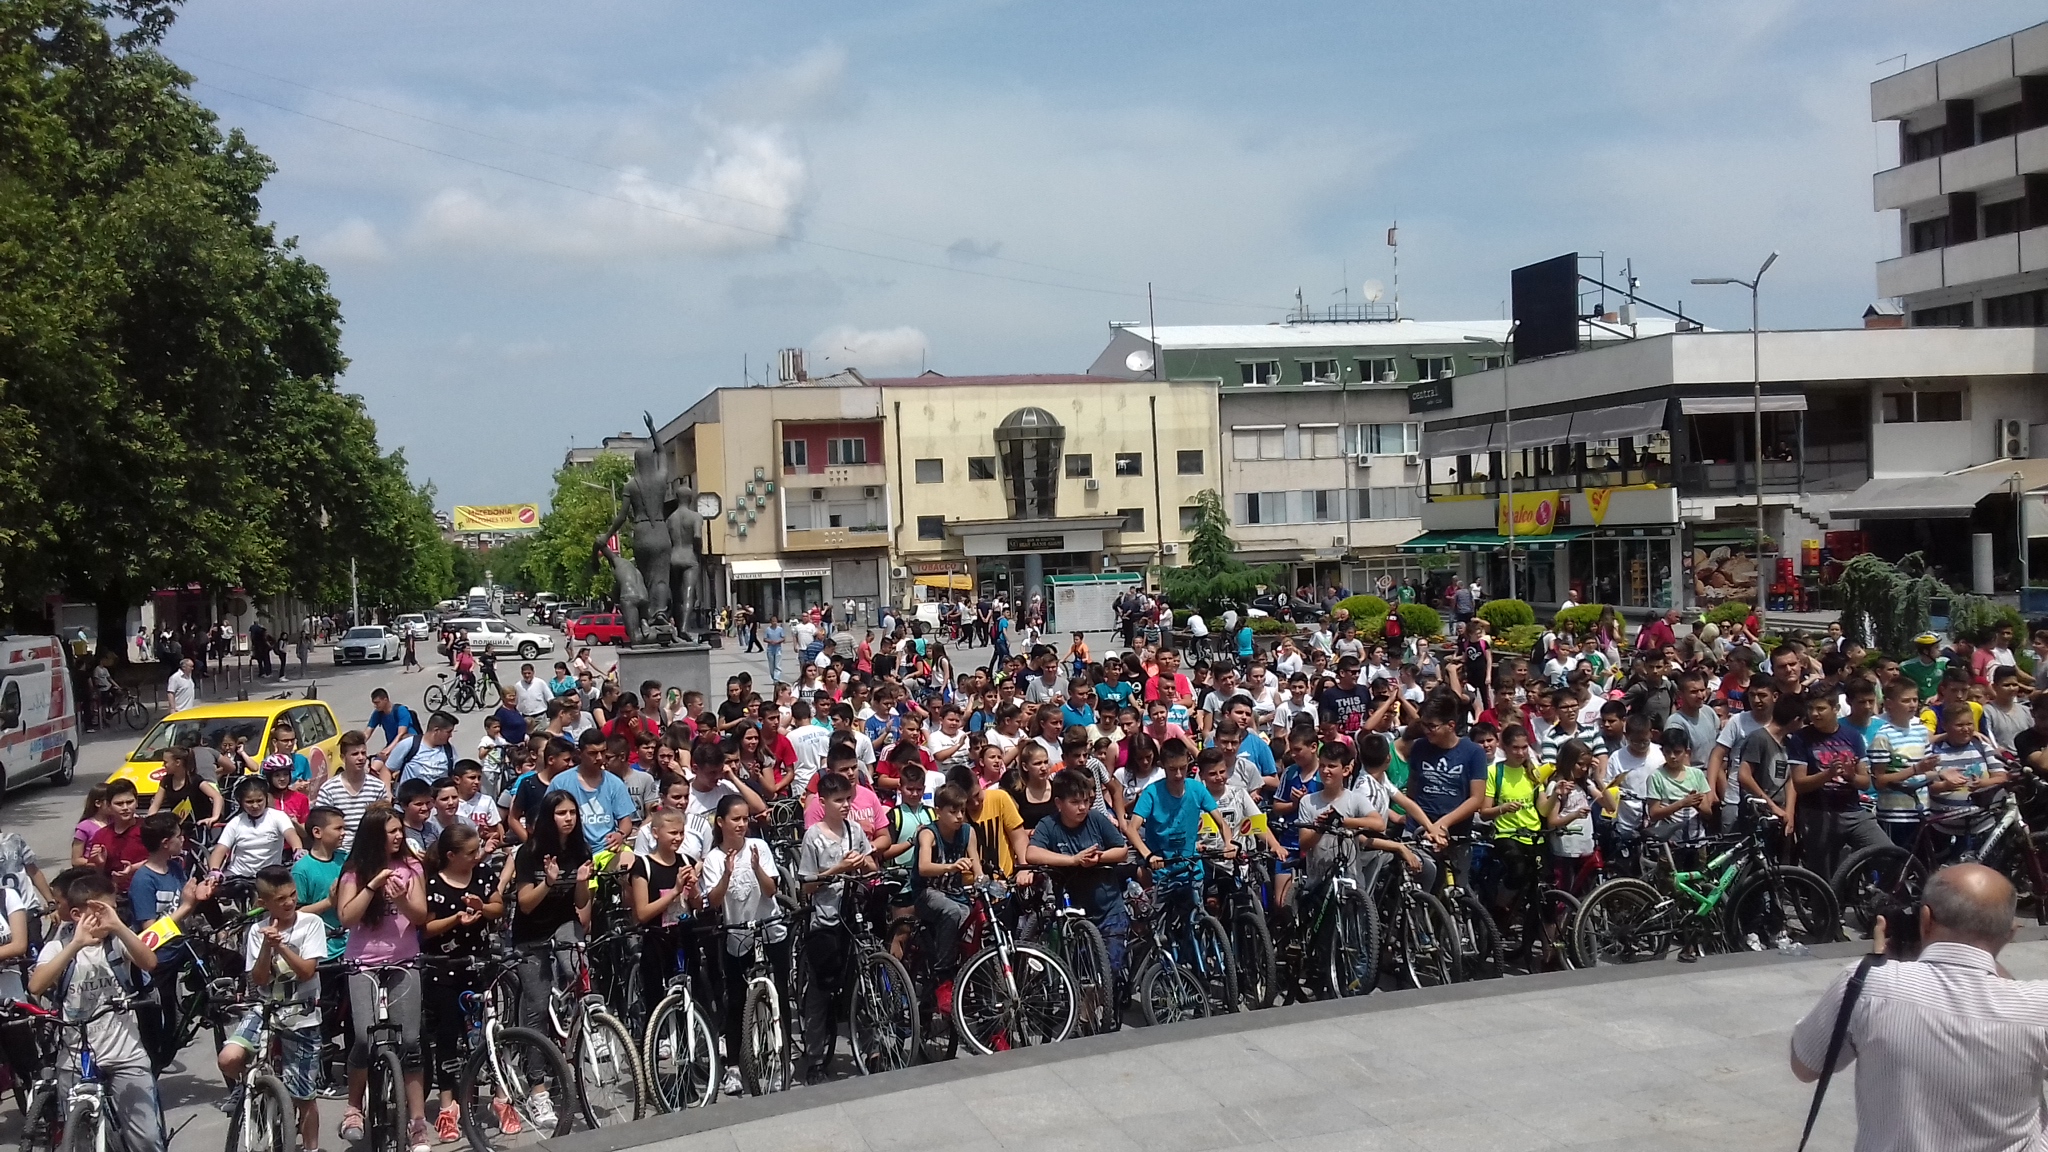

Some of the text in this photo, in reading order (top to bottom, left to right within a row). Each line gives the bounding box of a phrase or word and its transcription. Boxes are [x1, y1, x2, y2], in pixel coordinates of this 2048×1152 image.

[1412, 385, 1438, 400] central
[917, 562, 957, 572] TOBACCO
[1335, 696, 1361, 707] THIS
[1337, 703, 1367, 716] GAME
